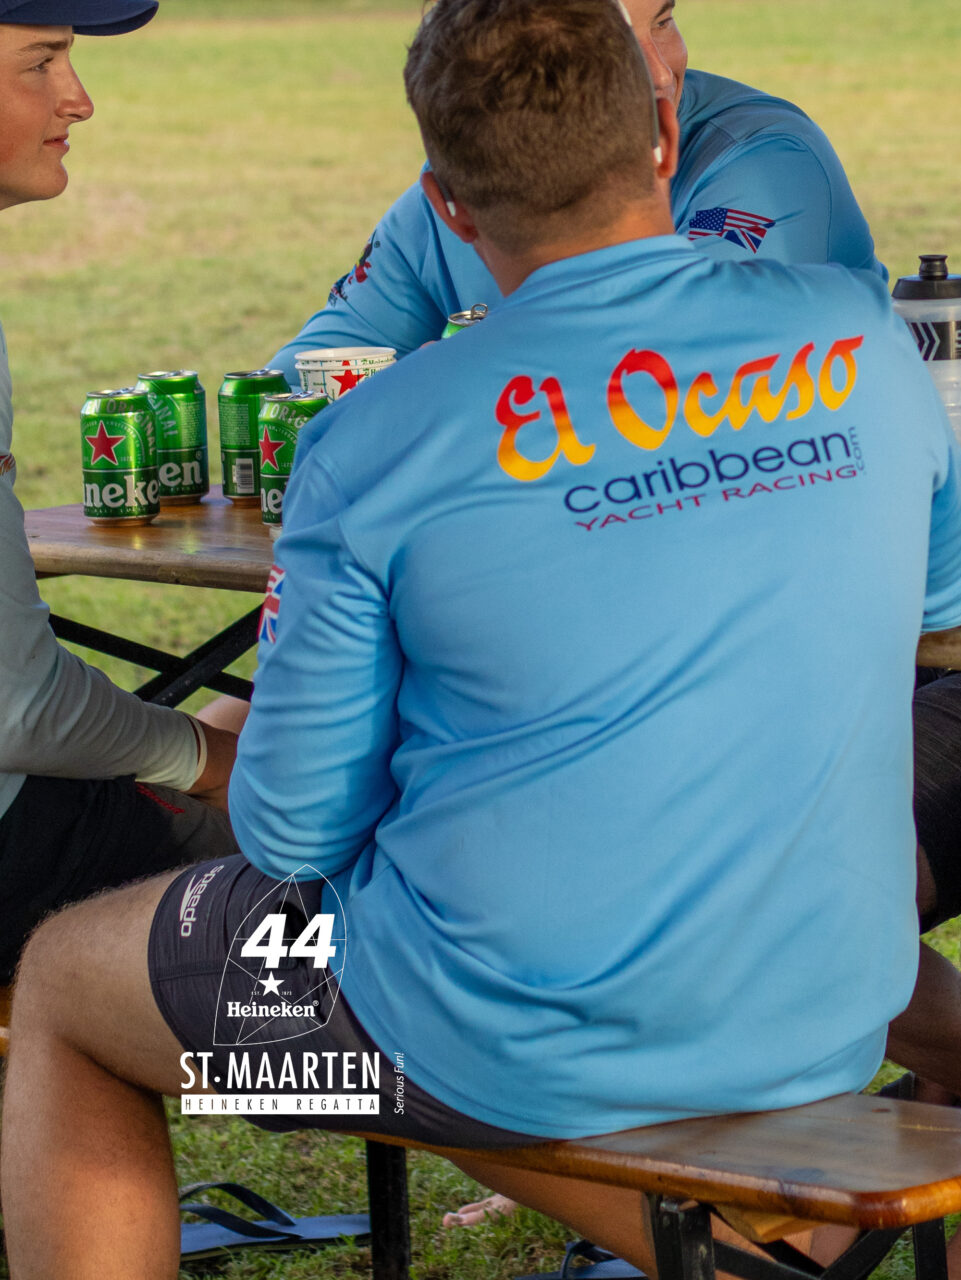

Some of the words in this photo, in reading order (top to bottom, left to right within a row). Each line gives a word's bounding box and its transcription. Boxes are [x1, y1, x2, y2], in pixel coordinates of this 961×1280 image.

[495, 374, 596, 482] El
[606, 334, 864, 451] Ocaso
[564, 432, 852, 513] caribbean
[574, 493, 706, 532] YACHT
[721, 464, 858, 502] RACING
[180, 864, 225, 938] speedo
